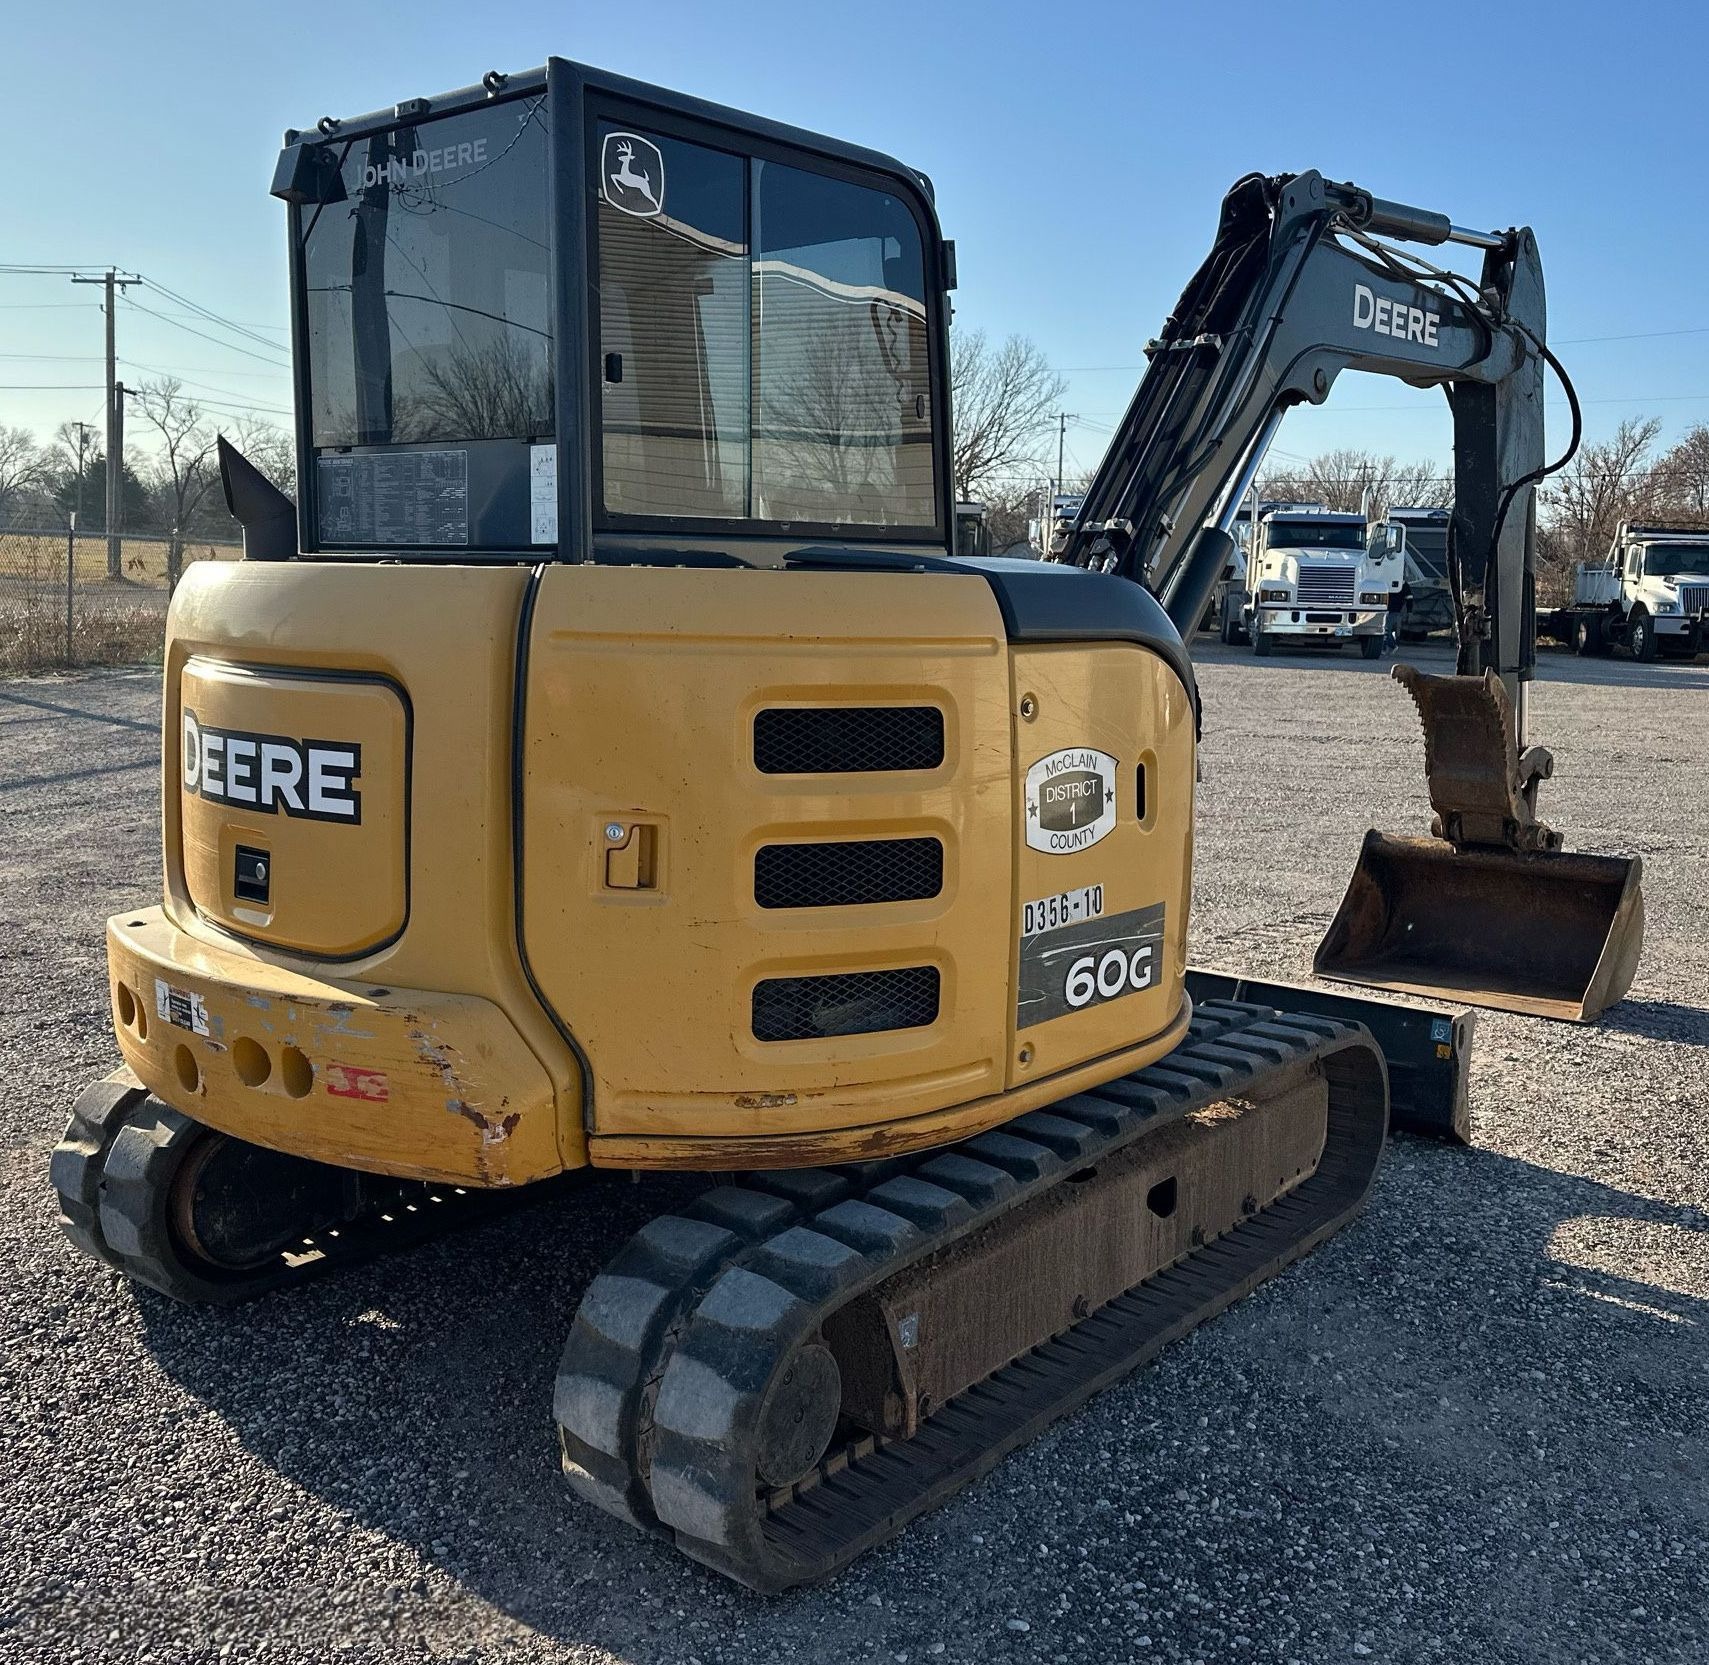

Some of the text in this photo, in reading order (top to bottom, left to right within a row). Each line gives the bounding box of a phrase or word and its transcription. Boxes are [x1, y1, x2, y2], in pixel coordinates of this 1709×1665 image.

[356, 138, 488, 189] JOHN DEERE
[1353, 283, 1440, 347] DEERE
[183, 714, 355, 816] DEERE
[1045, 753, 1098, 778] McCLAIN
[1046, 779, 1098, 803] DISTRICT
[1069, 802, 1076, 825] 1
[1050, 824, 1096, 849] COUNTY
[1025, 887, 1102, 933] D356-10
[1065, 946, 1152, 1007] 60G
